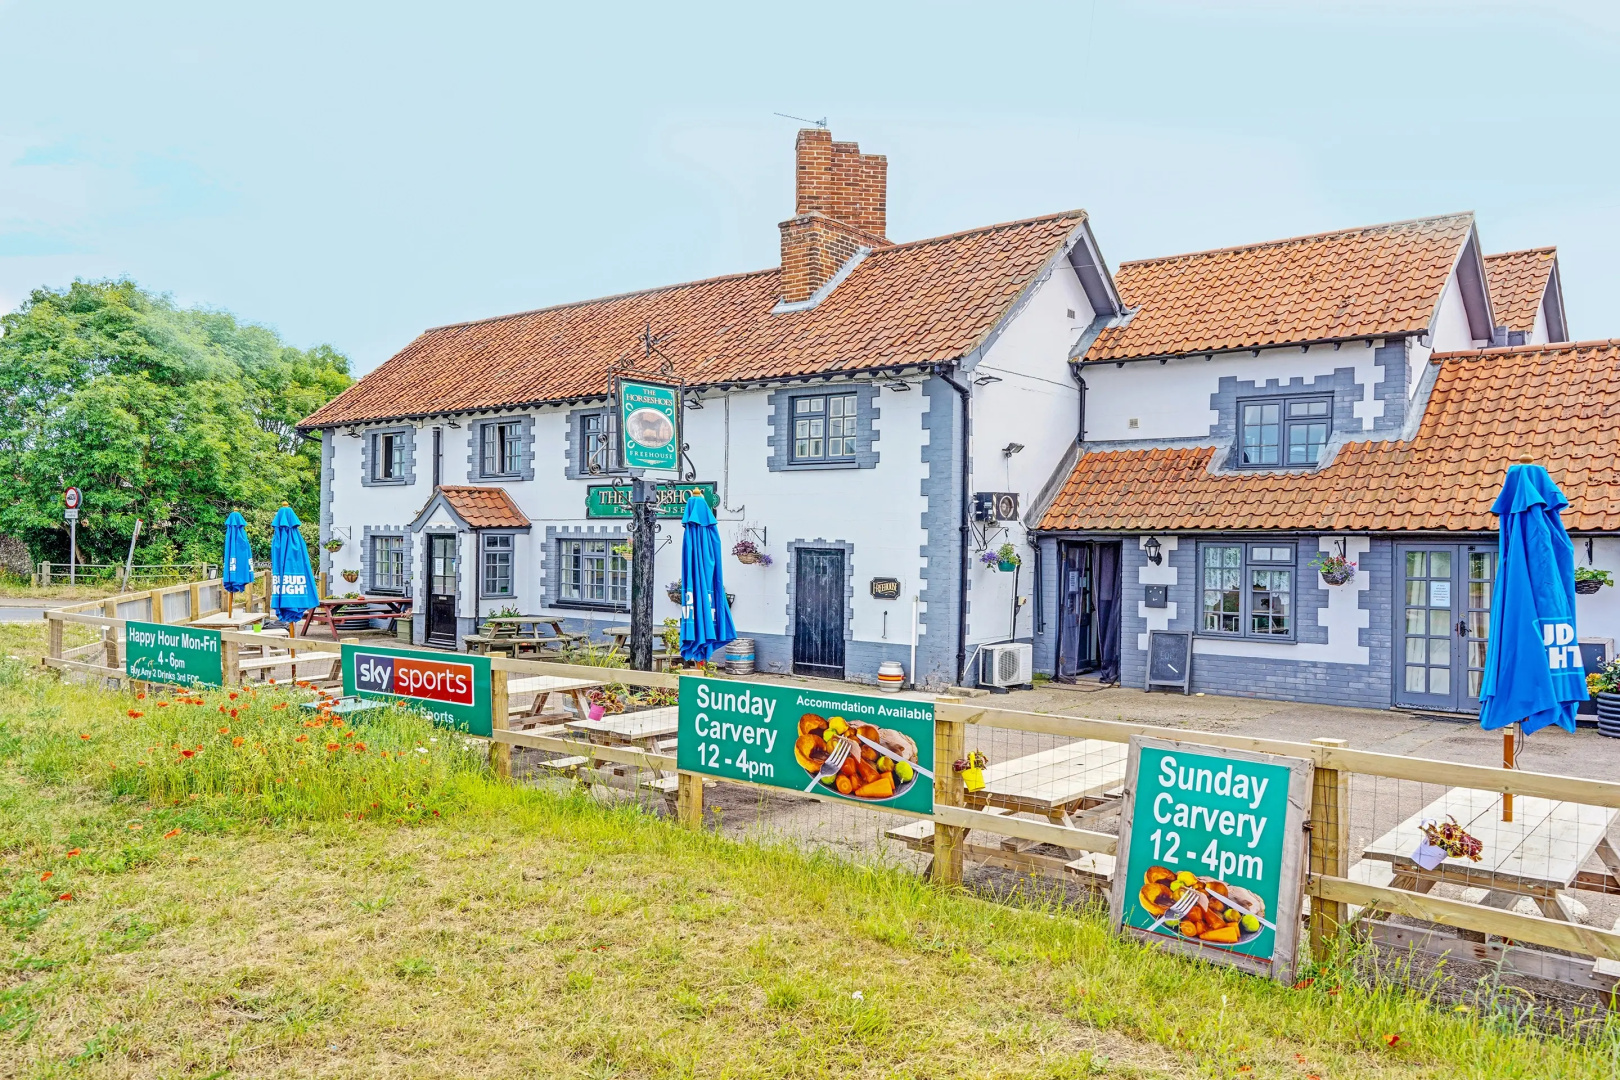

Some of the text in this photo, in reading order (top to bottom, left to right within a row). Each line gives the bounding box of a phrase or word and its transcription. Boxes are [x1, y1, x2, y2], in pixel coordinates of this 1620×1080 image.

[626, 394, 672, 406] HORSESHOES
[630, 450, 673, 460] FREEHOUSE
[599, 490, 624, 505] THE
[129, 627, 217, 652] Happy Hour Mon-Fri
[130, 666, 140, 677] Buy
[141, 668, 152, 678] Any
[152, 669, 156, 678] 2
[158, 670, 176, 680] Drinks
[176, 672, 186, 682] 3rd
[158, 650, 164, 665] 4
[170, 652, 185, 670] 6pm
[360, 658, 467, 694] sky sports
[696, 684, 776, 722] Sunday
[796, 695, 932, 721] Accommdation Available
[694, 713, 778, 753] Carvery
[698, 742, 720, 768] 12
[736, 749, 774, 778] 4pm
[1158, 756, 1268, 810] Sunday
[1153, 792, 1268, 848] Carvery
[1150, 829, 1180, 864] 12
[1202, 839, 1263, 880] 4pm
